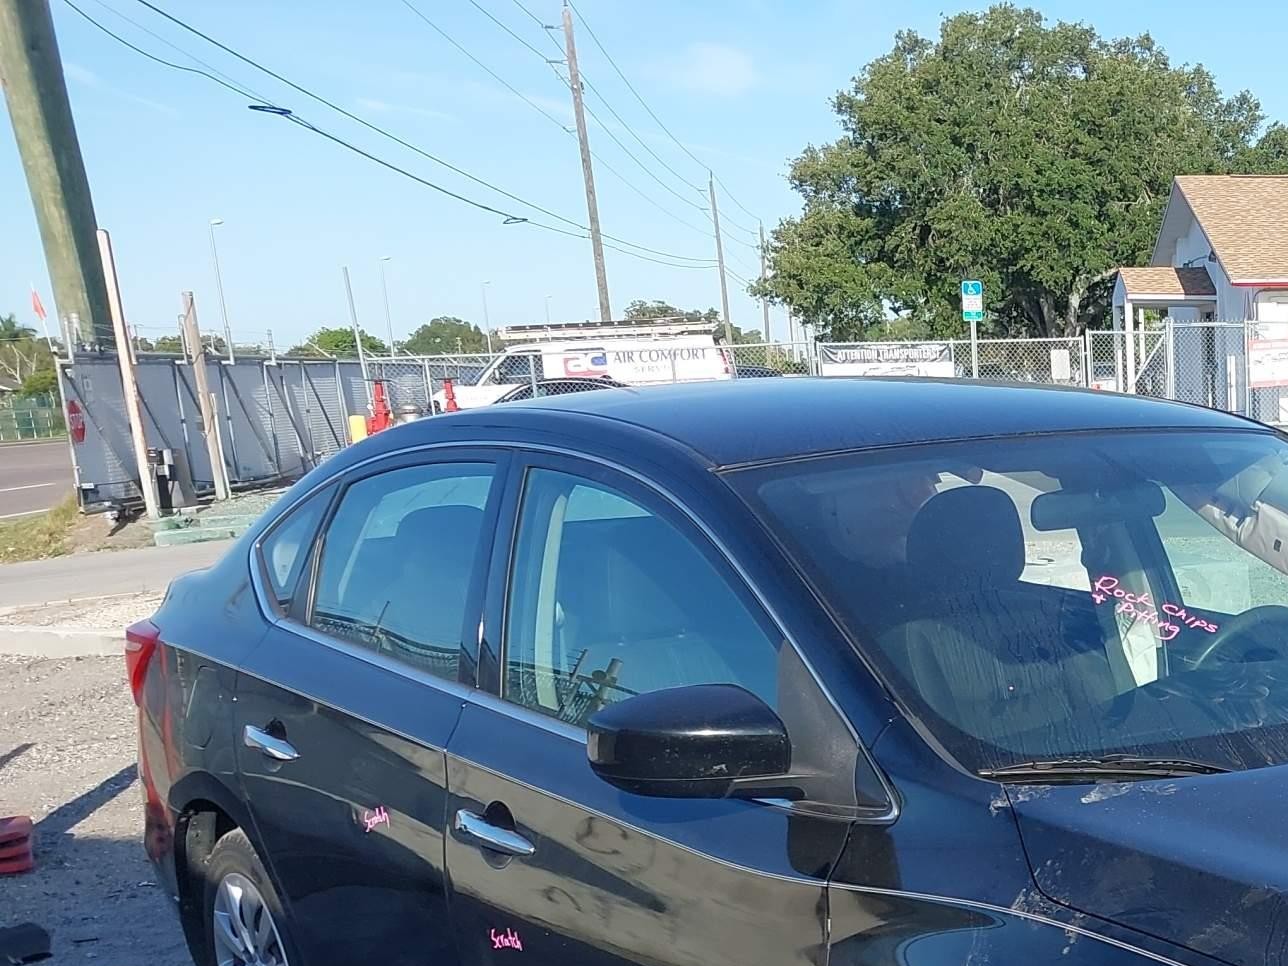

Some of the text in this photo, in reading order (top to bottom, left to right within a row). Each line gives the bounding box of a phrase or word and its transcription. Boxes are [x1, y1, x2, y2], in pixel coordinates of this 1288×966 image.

[613, 347, 706, 364] AIR COMFORT
[836, 348, 876, 362] ATTENTION
[1094, 576, 1155, 608] Rock
[1161, 603, 1219, 634] Chips
